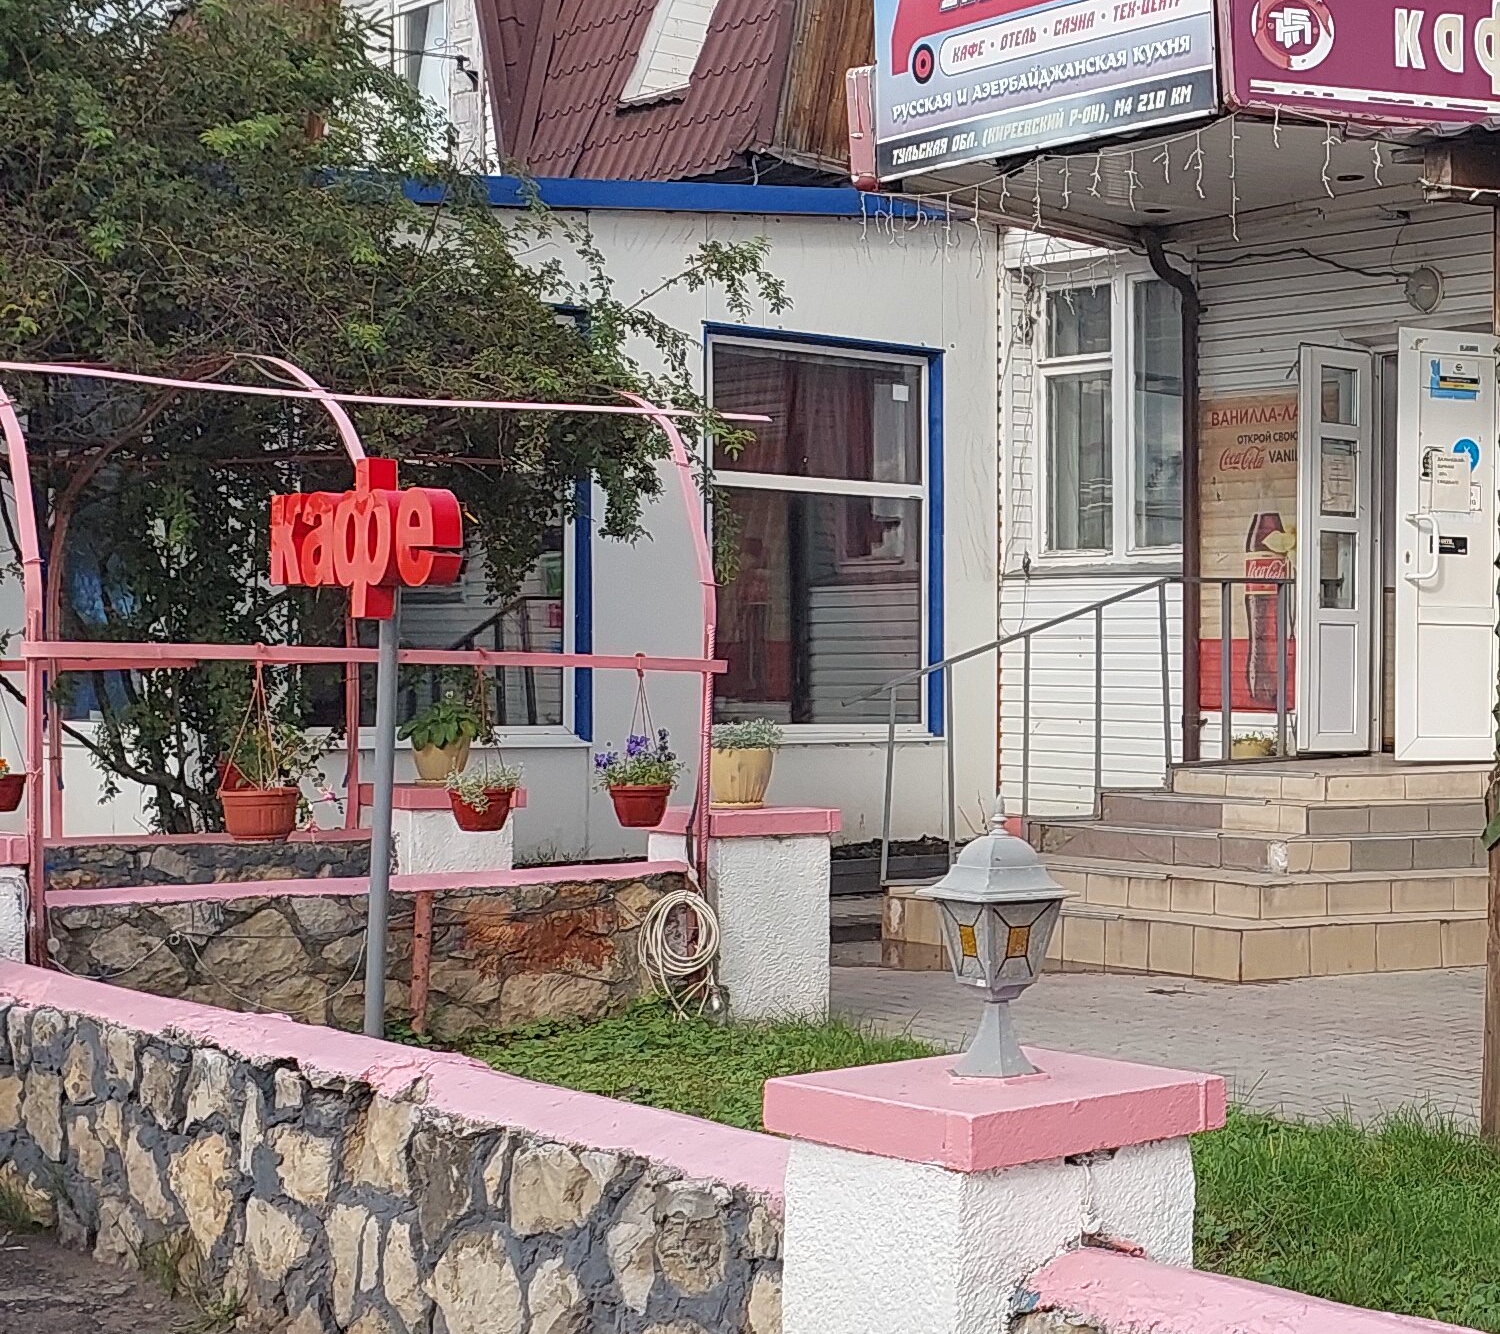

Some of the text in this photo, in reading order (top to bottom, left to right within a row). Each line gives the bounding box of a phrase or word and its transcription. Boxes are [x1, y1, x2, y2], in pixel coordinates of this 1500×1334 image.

[891, 34, 1191, 122] РУССКАЯ И АЗЕРБАЙДЖАНСКАЯ КУХНЯ
[952, 39, 986, 64] КАФЕ
[1000, 26, 1037, 51] ОТЕЛЬ
[1053, 10, 1095, 37] САУНА
[892, 137, 949, 166] ТУЛЬСКАЯ
[951, 133, 978, 153] ОБЛ.
[982, 107, 1065, 147] (КИРЕЕВСКИЙ
[1113, 96, 1133, 118] М4
[1137, 89, 1167, 113] 210
[1170, 84, 1193, 107] КМ
[1237, 430, 1271, 444] ОТКРОЙ
[270, 458, 464, 620] кафе
